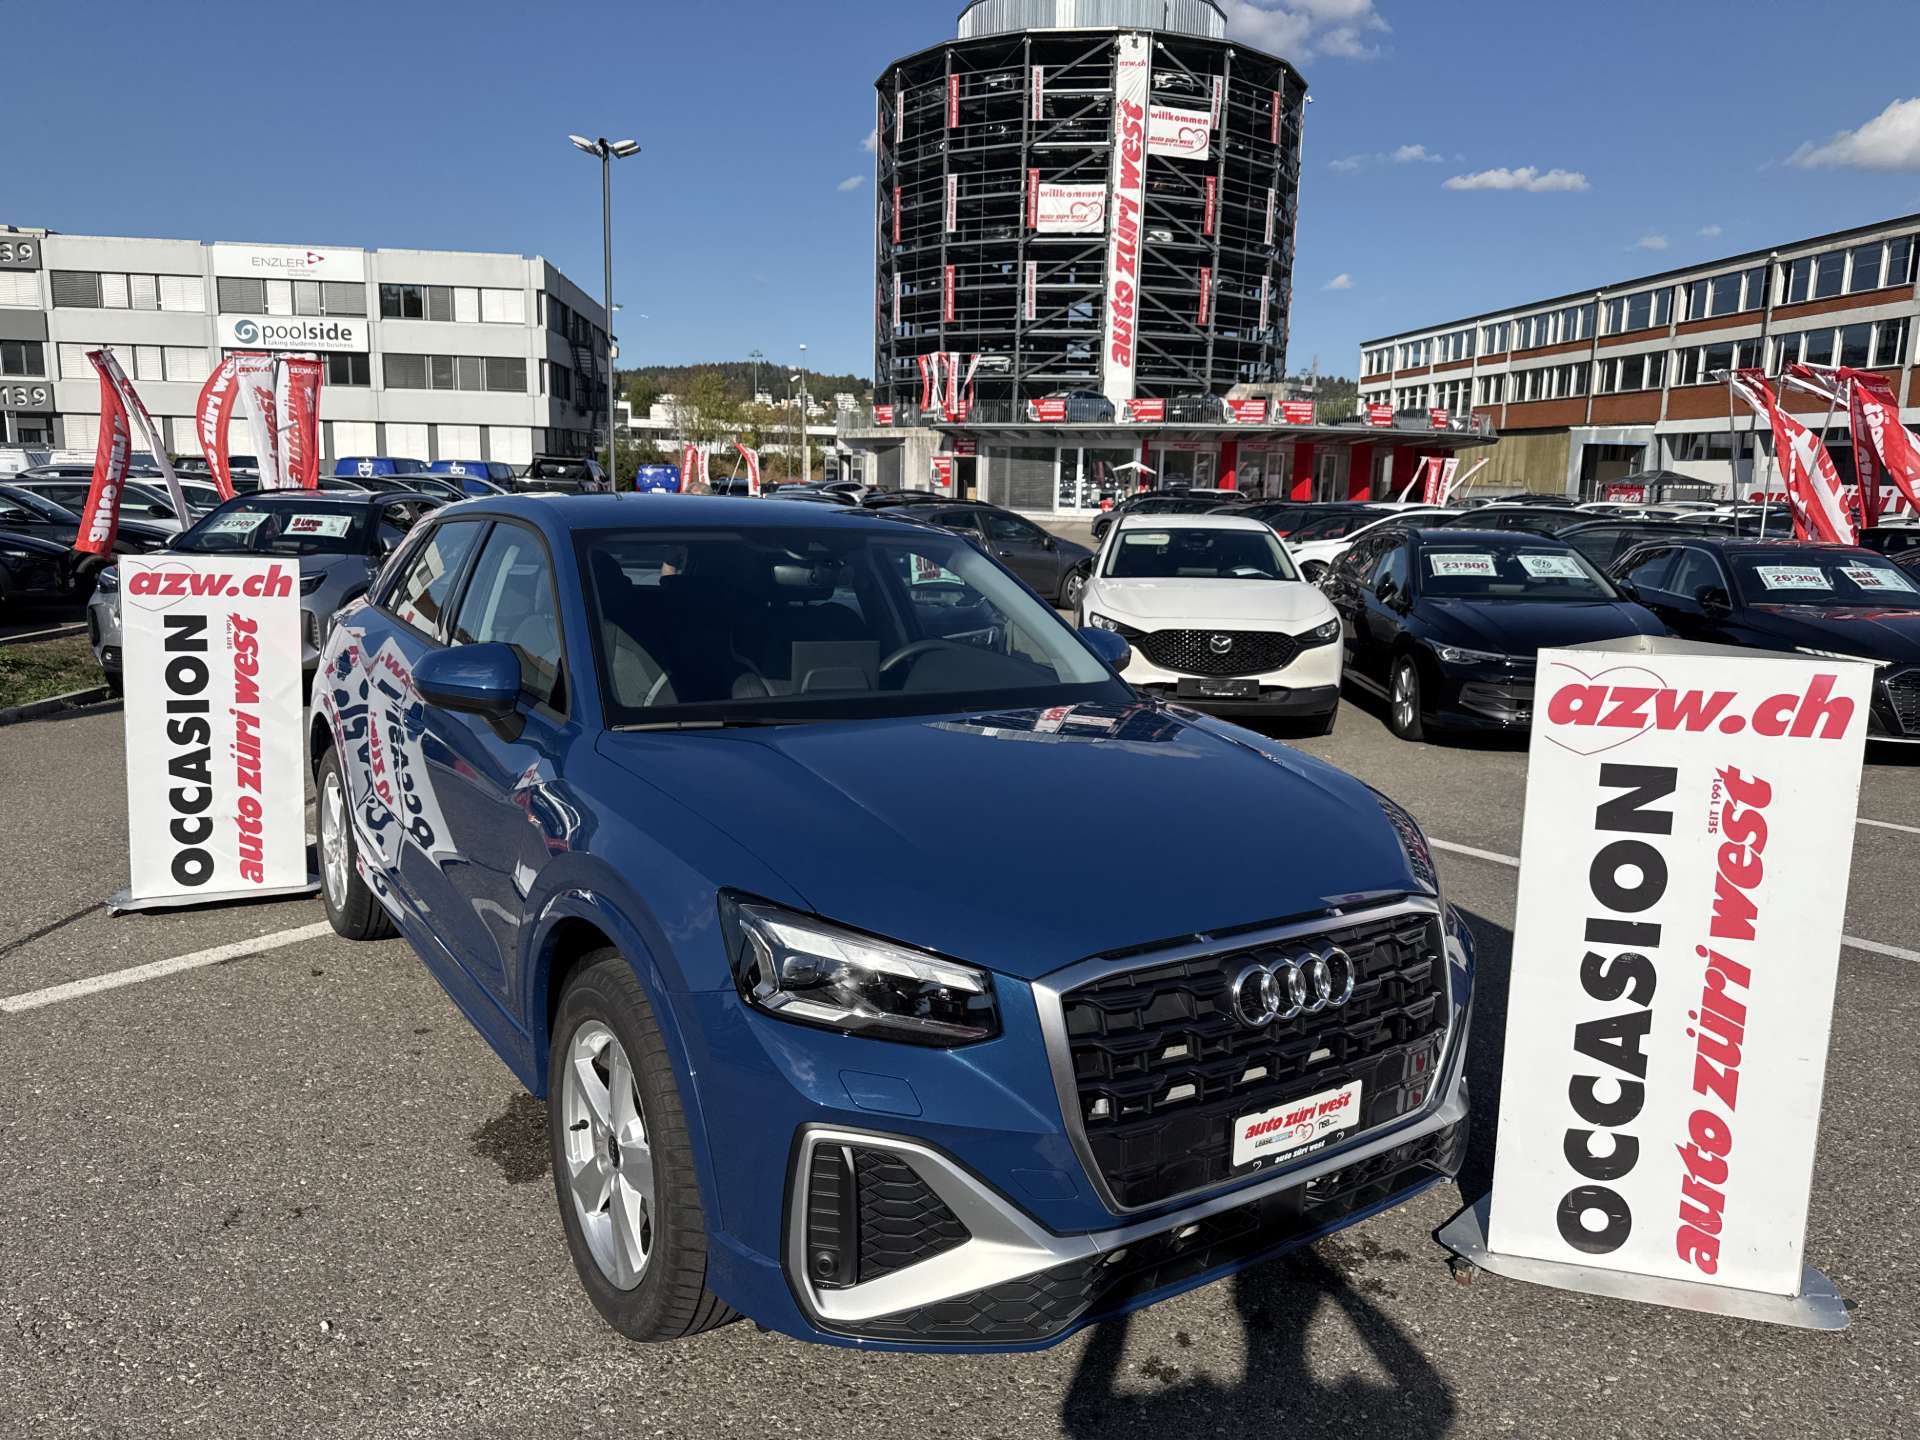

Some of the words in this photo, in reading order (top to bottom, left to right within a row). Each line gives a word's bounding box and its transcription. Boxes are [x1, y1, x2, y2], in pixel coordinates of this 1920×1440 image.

[1120, 98, 1144, 189] west
[1151, 111, 1209, 126] willkommen
[1040, 189, 1105, 198] willkommen
[251, 256, 305, 268] ENZLER
[1111, 193, 1139, 279] züri
[262, 321, 352, 345] poolside
[1110, 280, 1134, 368] auto
[2, 386, 47, 406] 139
[201, 394, 222, 447] züri
[129, 564, 293, 597] azw.ch
[229, 612, 260, 704] west
[1547, 673, 1855, 741] azw.ch
[164, 614, 215, 887] OCCASION
[228, 708, 263, 796] züri
[1707, 805, 1719, 835] SEIT
[1710, 776, 1723, 804] 1991
[232, 796, 264, 884] auto
[1709, 764, 1772, 942] west
[1556, 761, 1679, 1256] OCCASION
[1685, 944, 1752, 1113] züri
[1245, 1116, 1283, 1140] auto
[1284, 1102, 1318, 1128] züri
[1317, 1091, 1353, 1115] west
[1275, 1152, 1292, 1164] auto
[1309, 1139, 1326, 1152] west
[1676, 1108, 1732, 1276] auto
